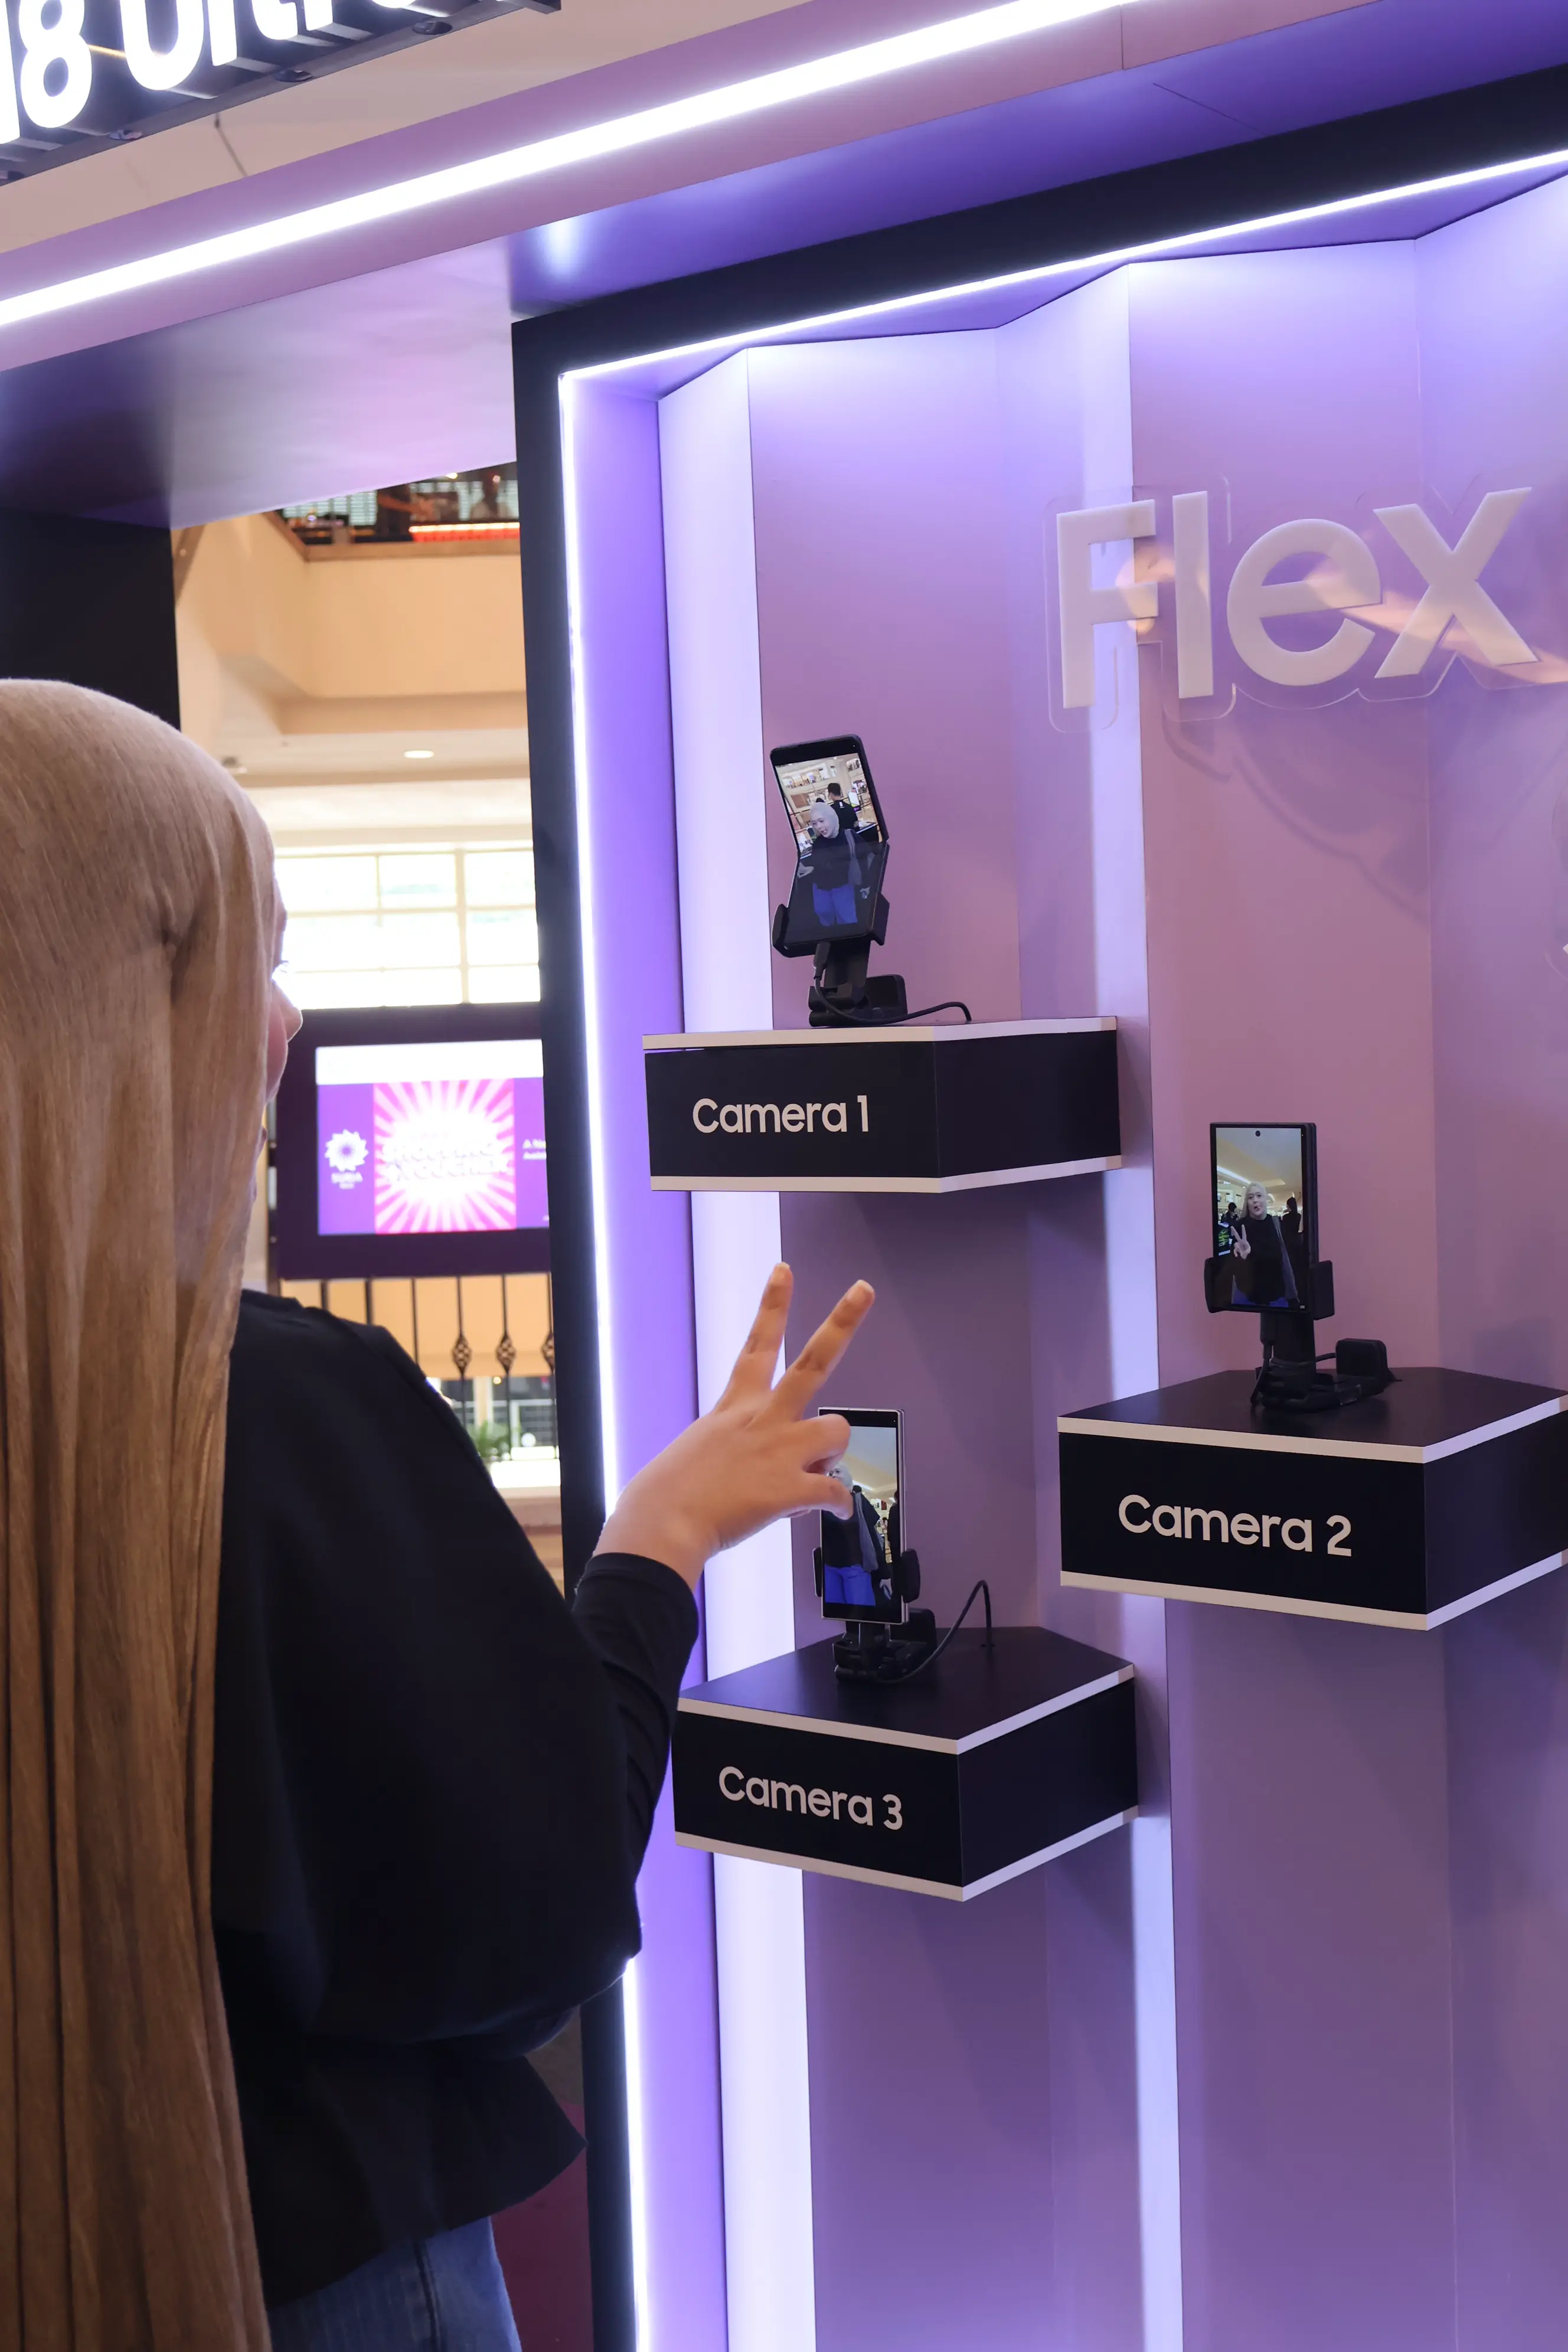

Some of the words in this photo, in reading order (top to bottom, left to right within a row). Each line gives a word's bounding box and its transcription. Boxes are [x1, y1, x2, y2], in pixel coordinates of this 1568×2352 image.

[1056, 486, 1538, 709] Flex
[692, 1098, 847, 1133] Camera
[857, 1095, 868, 1132] 1
[1119, 1494, 1312, 1552] Camera
[1326, 1515, 1352, 1557] 2
[719, 1766, 873, 1826] Camera
[883, 1794, 903, 1830] 3
